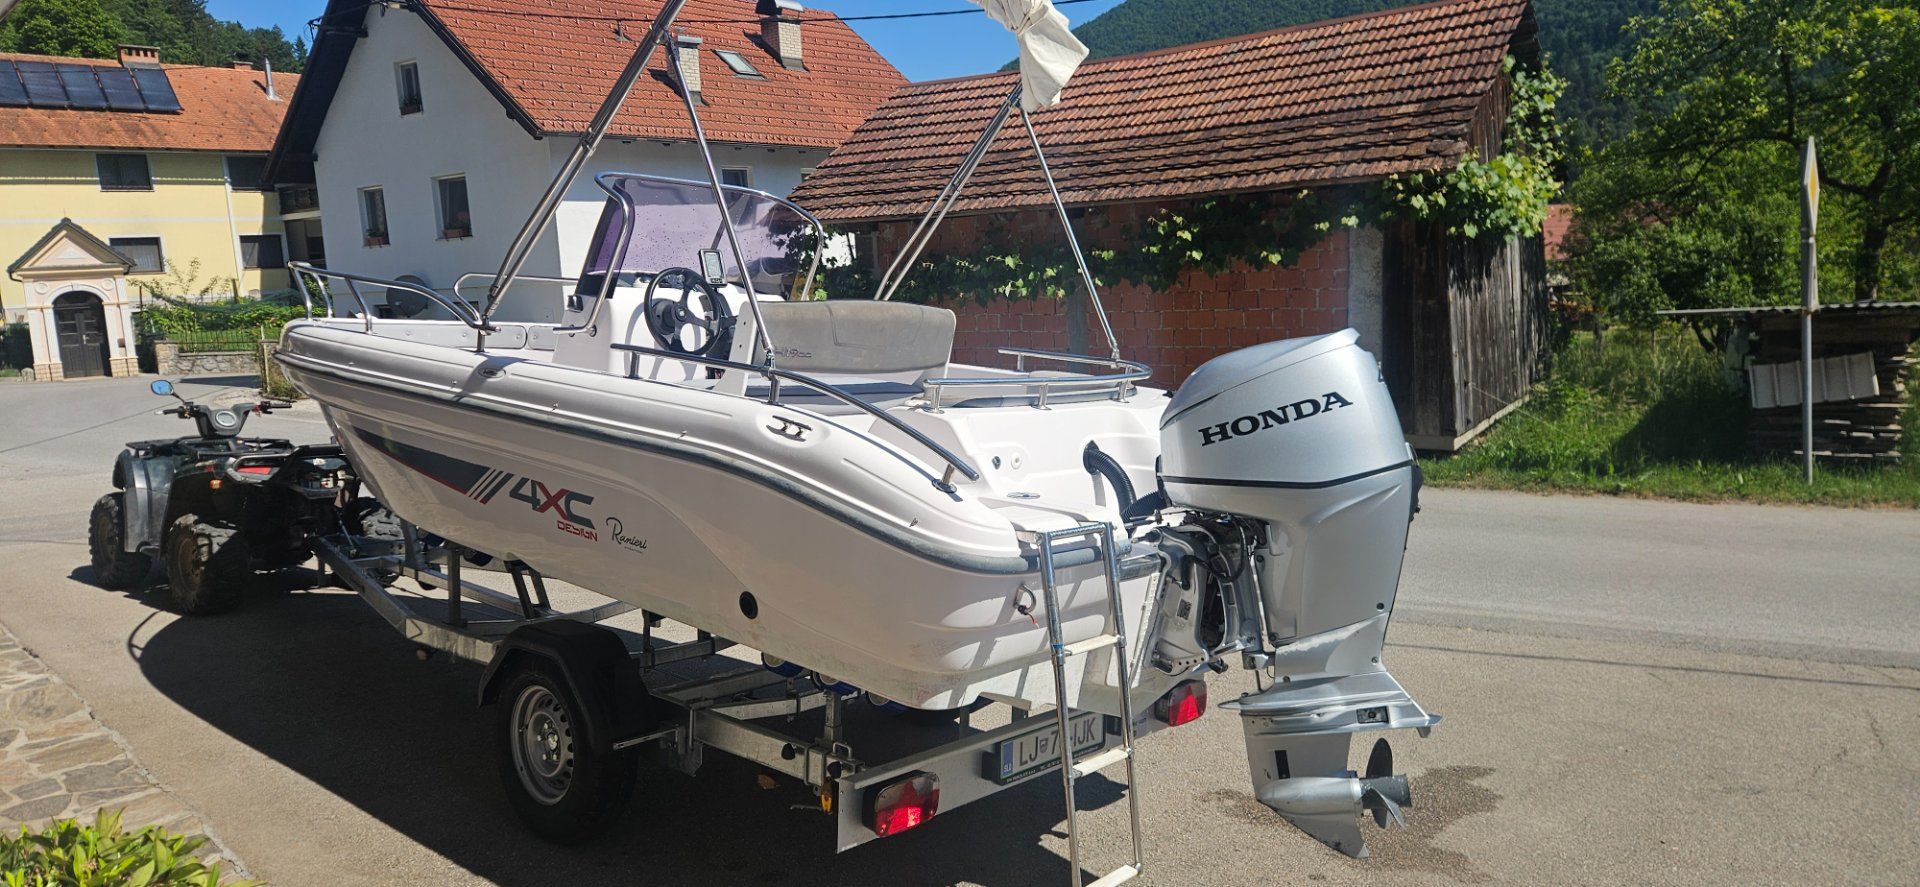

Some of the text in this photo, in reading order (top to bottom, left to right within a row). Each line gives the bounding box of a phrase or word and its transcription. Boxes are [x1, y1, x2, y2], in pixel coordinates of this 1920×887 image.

[1198, 391, 1353, 447] HONDA
[509, 477, 596, 530] 4XC
[557, 520, 598, 542] DESIGN
[605, 517, 647, 550] Ranieri
[1019, 717, 1096, 766] LJ 7-IJK
